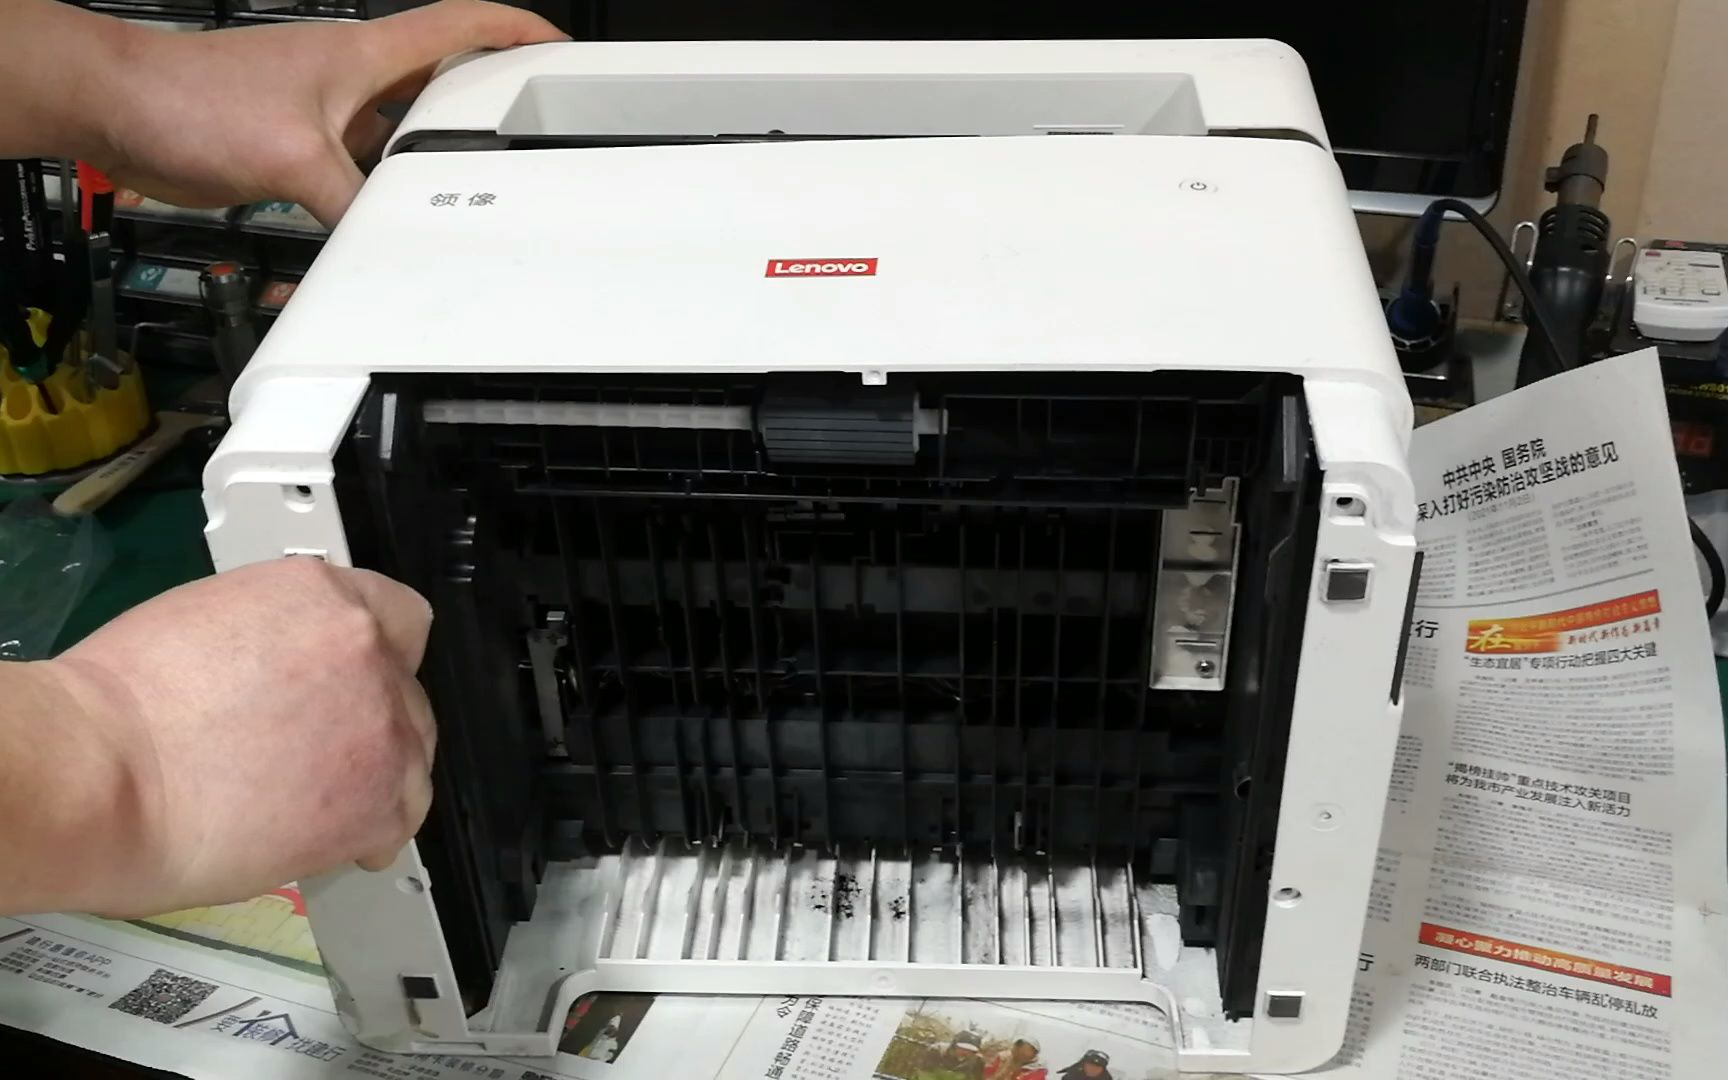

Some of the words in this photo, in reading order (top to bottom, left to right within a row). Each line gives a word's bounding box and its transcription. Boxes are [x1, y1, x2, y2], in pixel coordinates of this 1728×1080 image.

[430, 193, 497, 207] 领像
[774, 261, 869, 275] Lenovo
[1442, 455, 1497, 489] 中共中央
[1501, 438, 1547, 470] 国务院
[1445, 774, 1631, 818] 将为我市产业发展注入新活力
